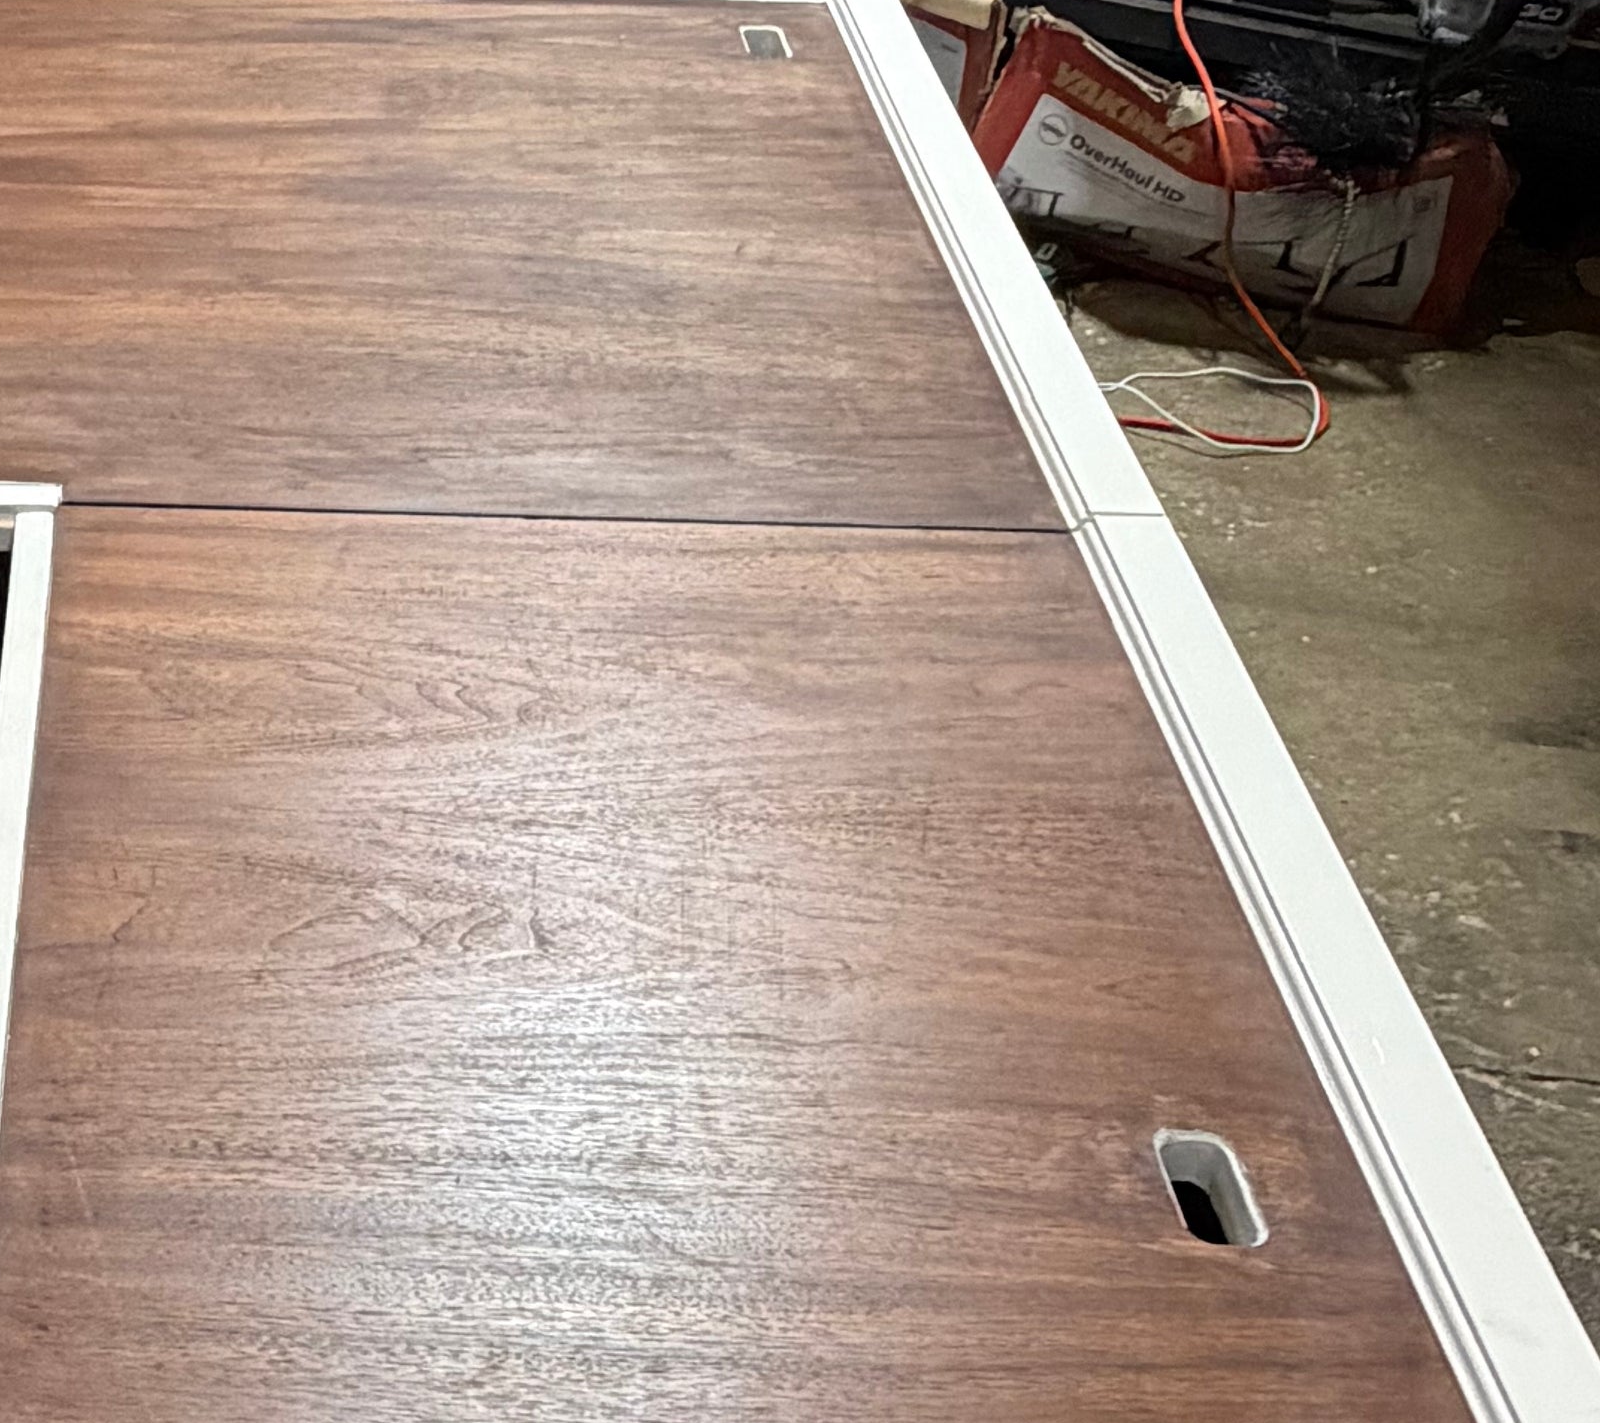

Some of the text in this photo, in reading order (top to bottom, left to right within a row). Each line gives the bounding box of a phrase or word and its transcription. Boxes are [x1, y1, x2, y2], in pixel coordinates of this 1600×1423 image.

[1052, 61, 1198, 164] YAKIMA
[1070, 133, 1154, 189] OverHaul
[1154, 179, 1186, 204] HD
